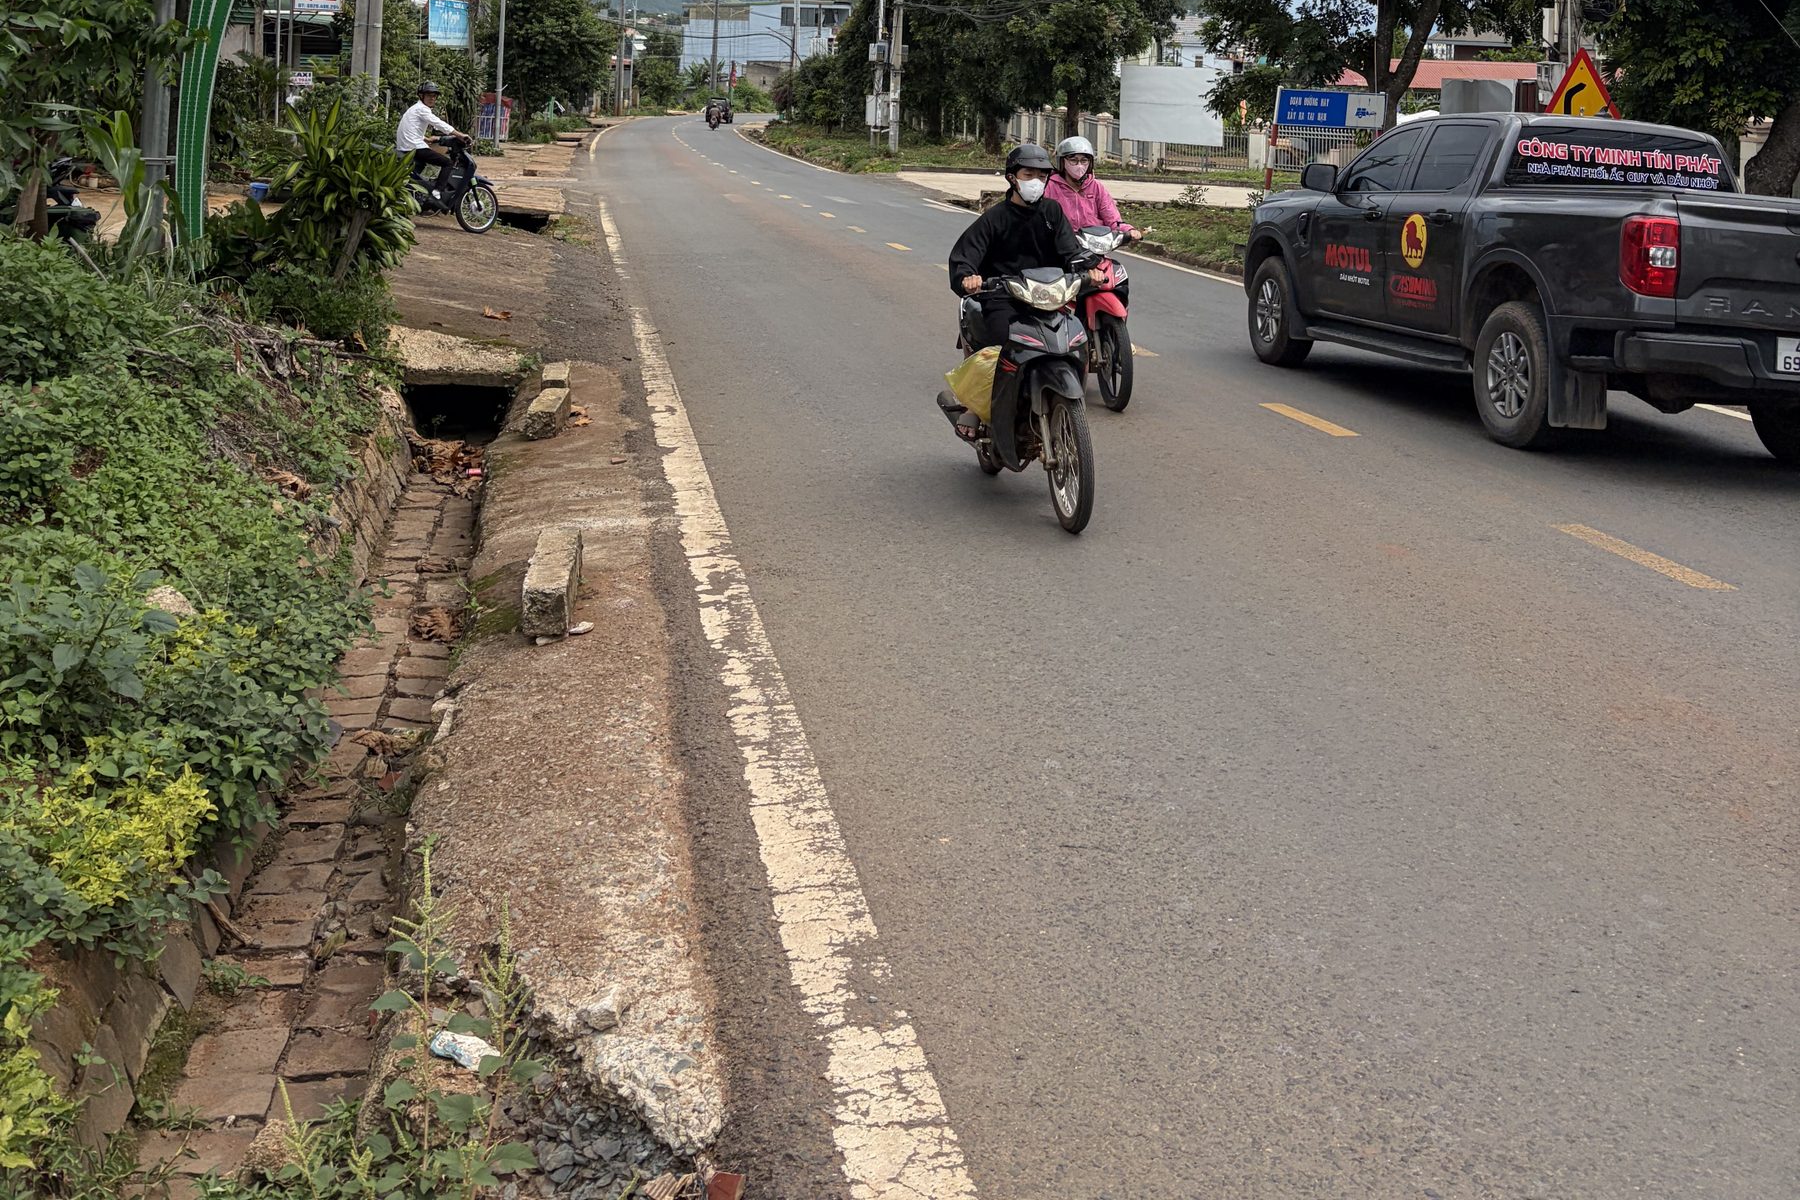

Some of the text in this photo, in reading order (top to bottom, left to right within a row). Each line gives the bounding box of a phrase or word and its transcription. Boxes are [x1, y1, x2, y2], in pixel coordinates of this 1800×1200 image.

[1518, 137, 1721, 175] CÔNG TY MINH TÍN PHÁT
[1528, 162, 1551, 174] NHÀ
[1626, 171, 1650, 184] QUY
[1650, 172, 1666, 185] VÀ
[1325, 244, 1372, 273] MOTUL
